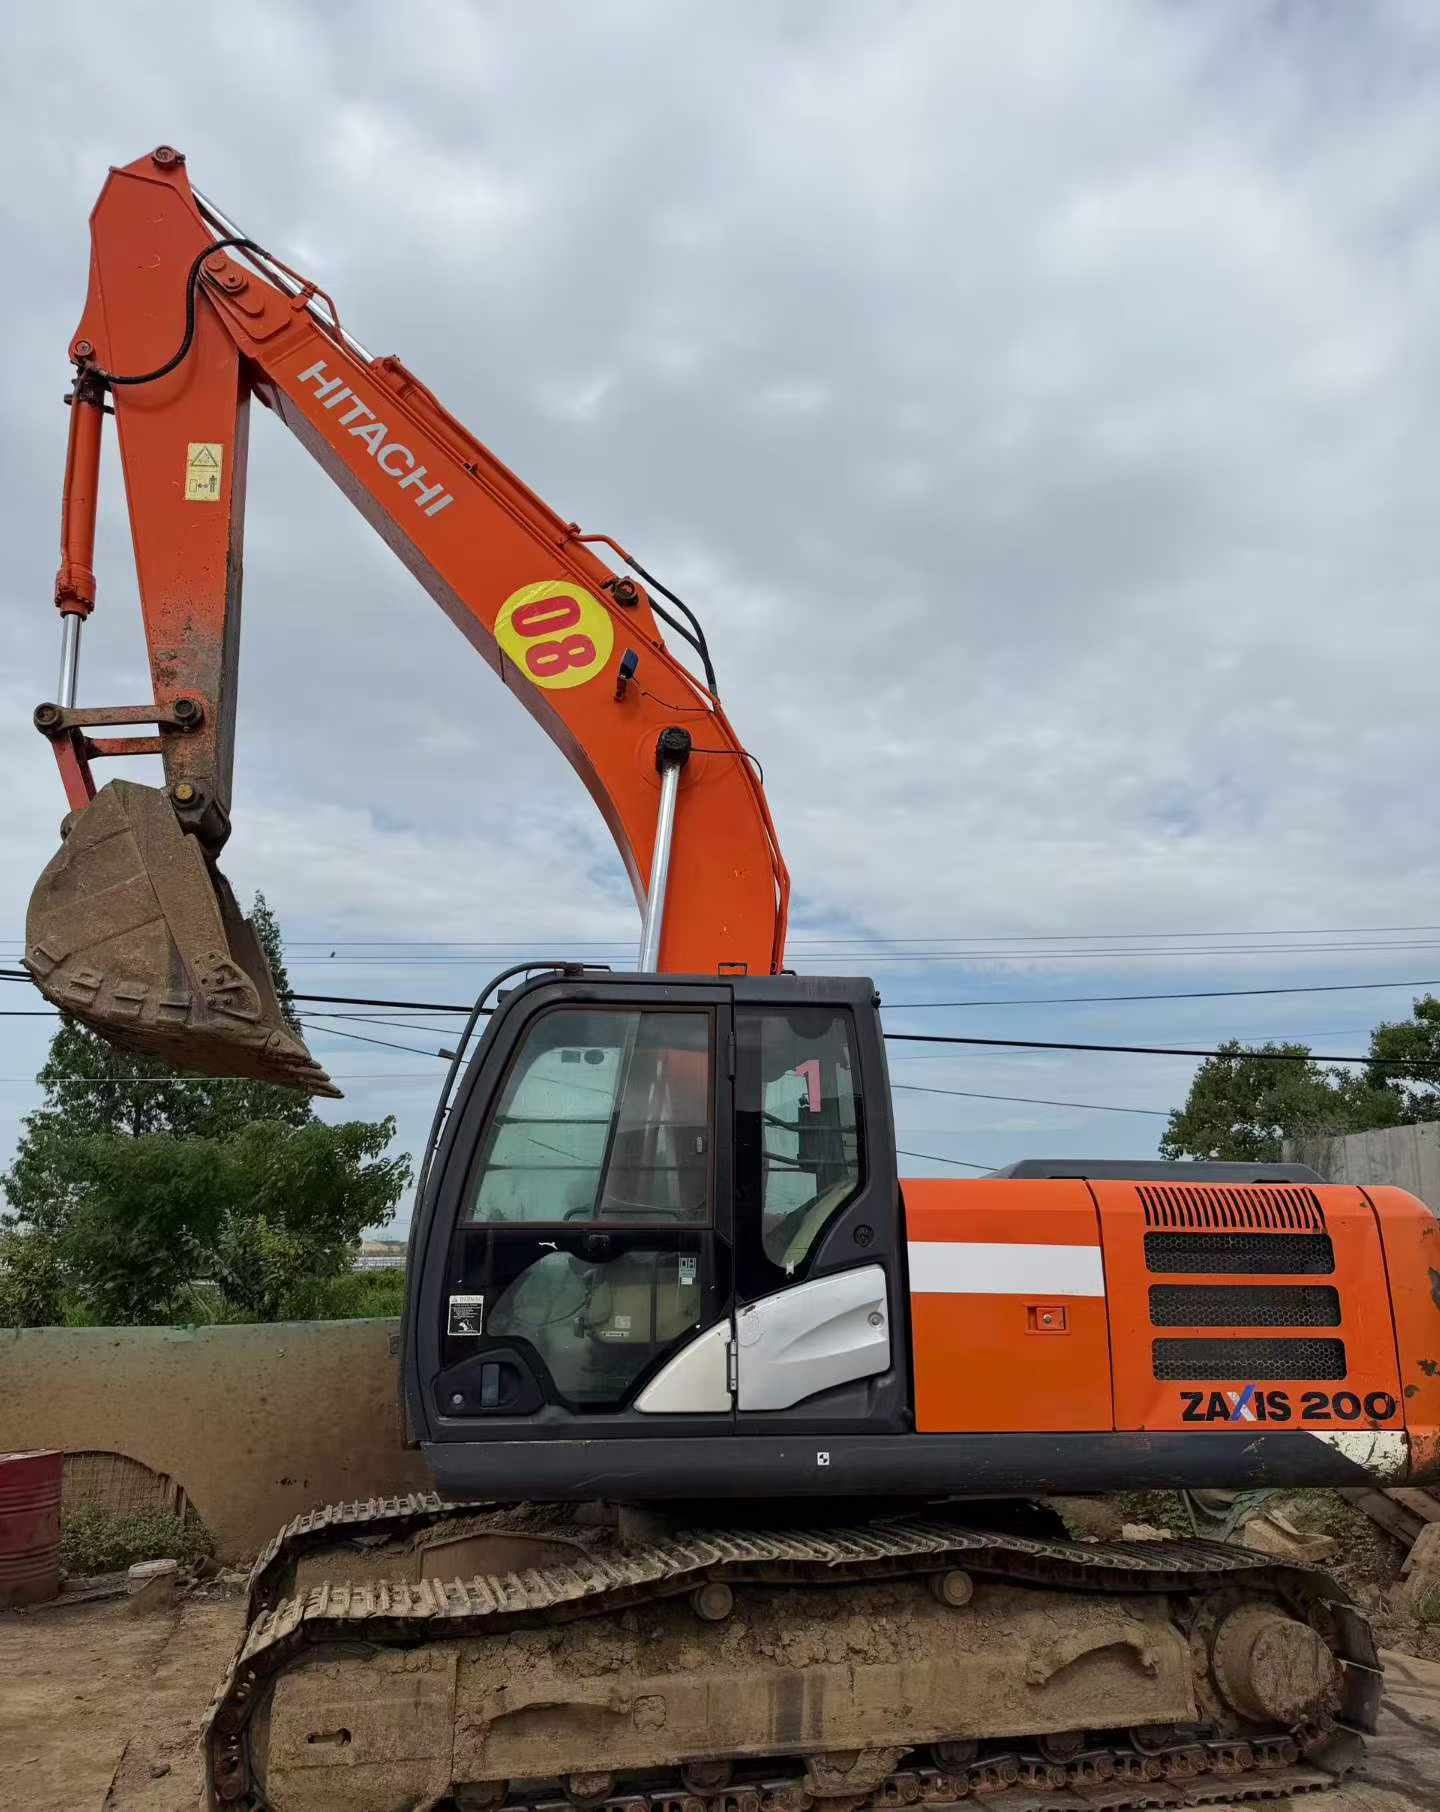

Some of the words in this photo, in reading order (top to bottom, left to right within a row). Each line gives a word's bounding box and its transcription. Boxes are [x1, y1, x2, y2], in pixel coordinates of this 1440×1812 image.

[297, 360, 454, 516] HITACHI
[511, 595, 596, 677] 08
[1180, 1385, 1292, 1421] ZAXIS
[1300, 1391, 1396, 1420] 200
